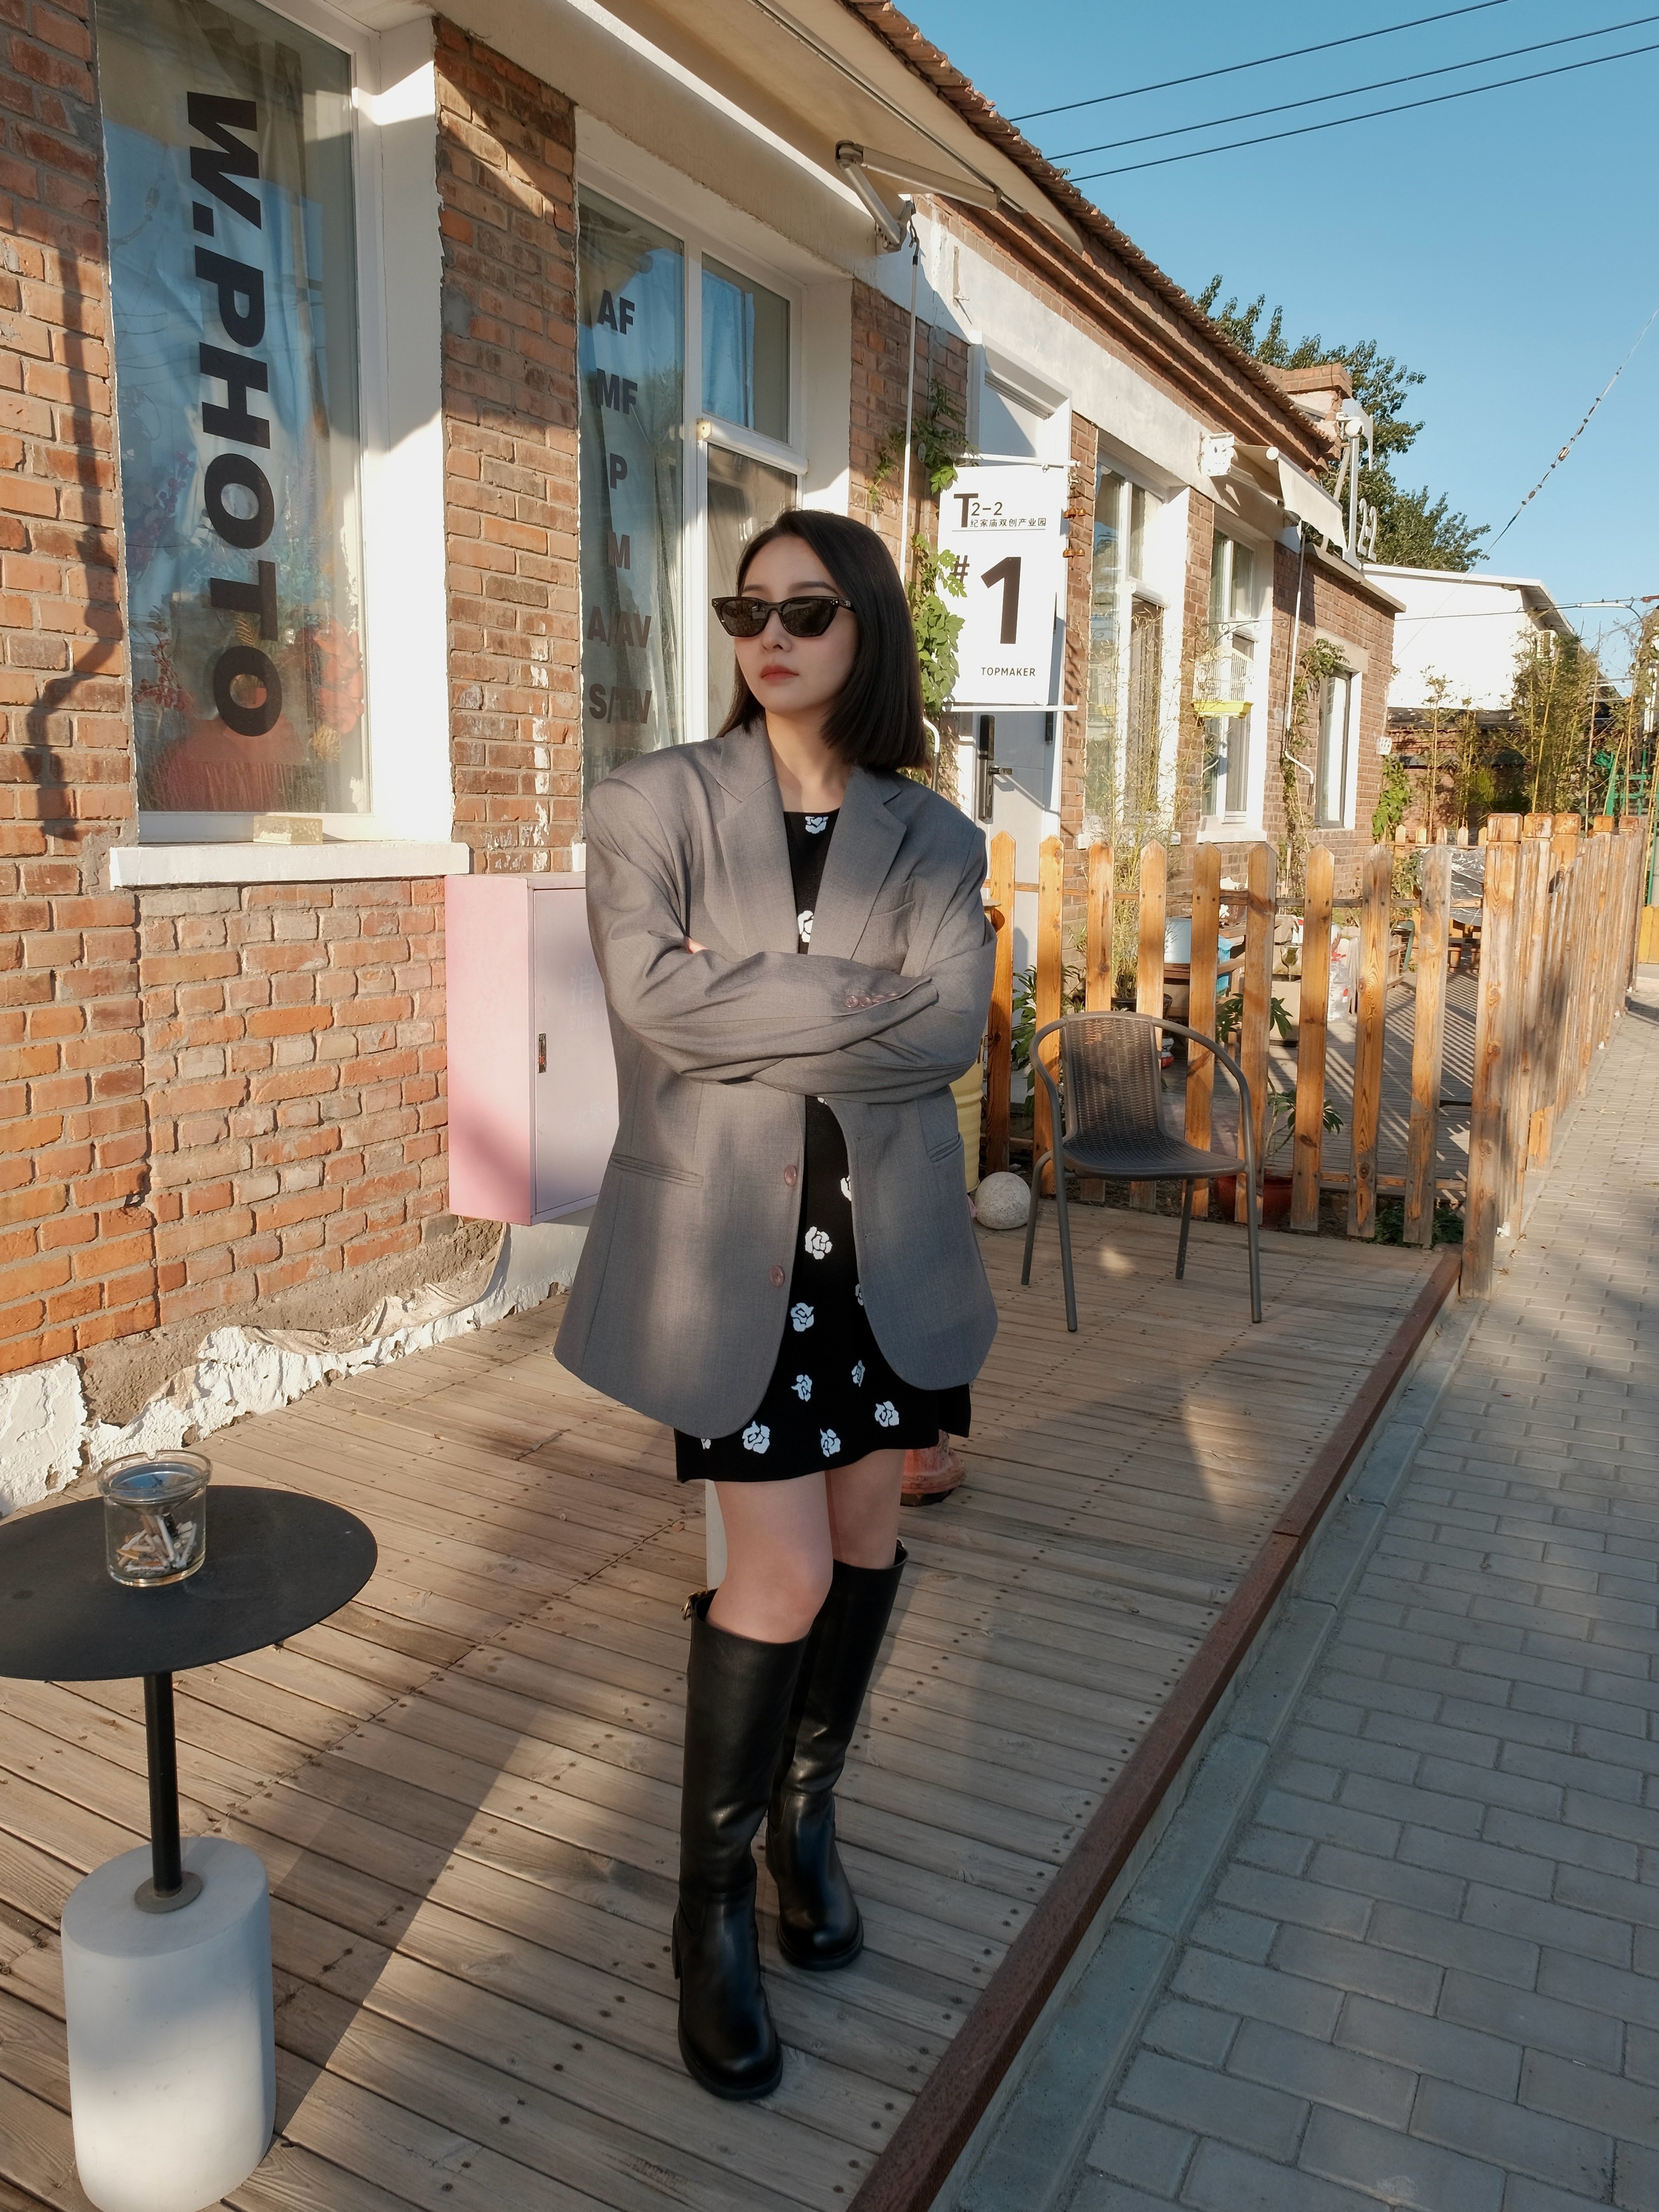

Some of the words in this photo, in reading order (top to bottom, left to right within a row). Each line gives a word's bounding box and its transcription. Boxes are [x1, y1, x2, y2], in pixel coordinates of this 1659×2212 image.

[597, 289, 635, 335] AF
[596, 368, 638, 415] MF
[187, 91, 284, 737] W.PHOTO
[610, 453, 629, 490] P
[970, 517, 1047, 528] 纪家庙双创产业园
[607, 531, 631, 570] M
[587, 606, 652, 649] A/AV
[981, 666, 1036, 677] TOPMAKER
[589, 683, 652, 724] S/TV
[570, 1011, 597, 1031] FIRE
